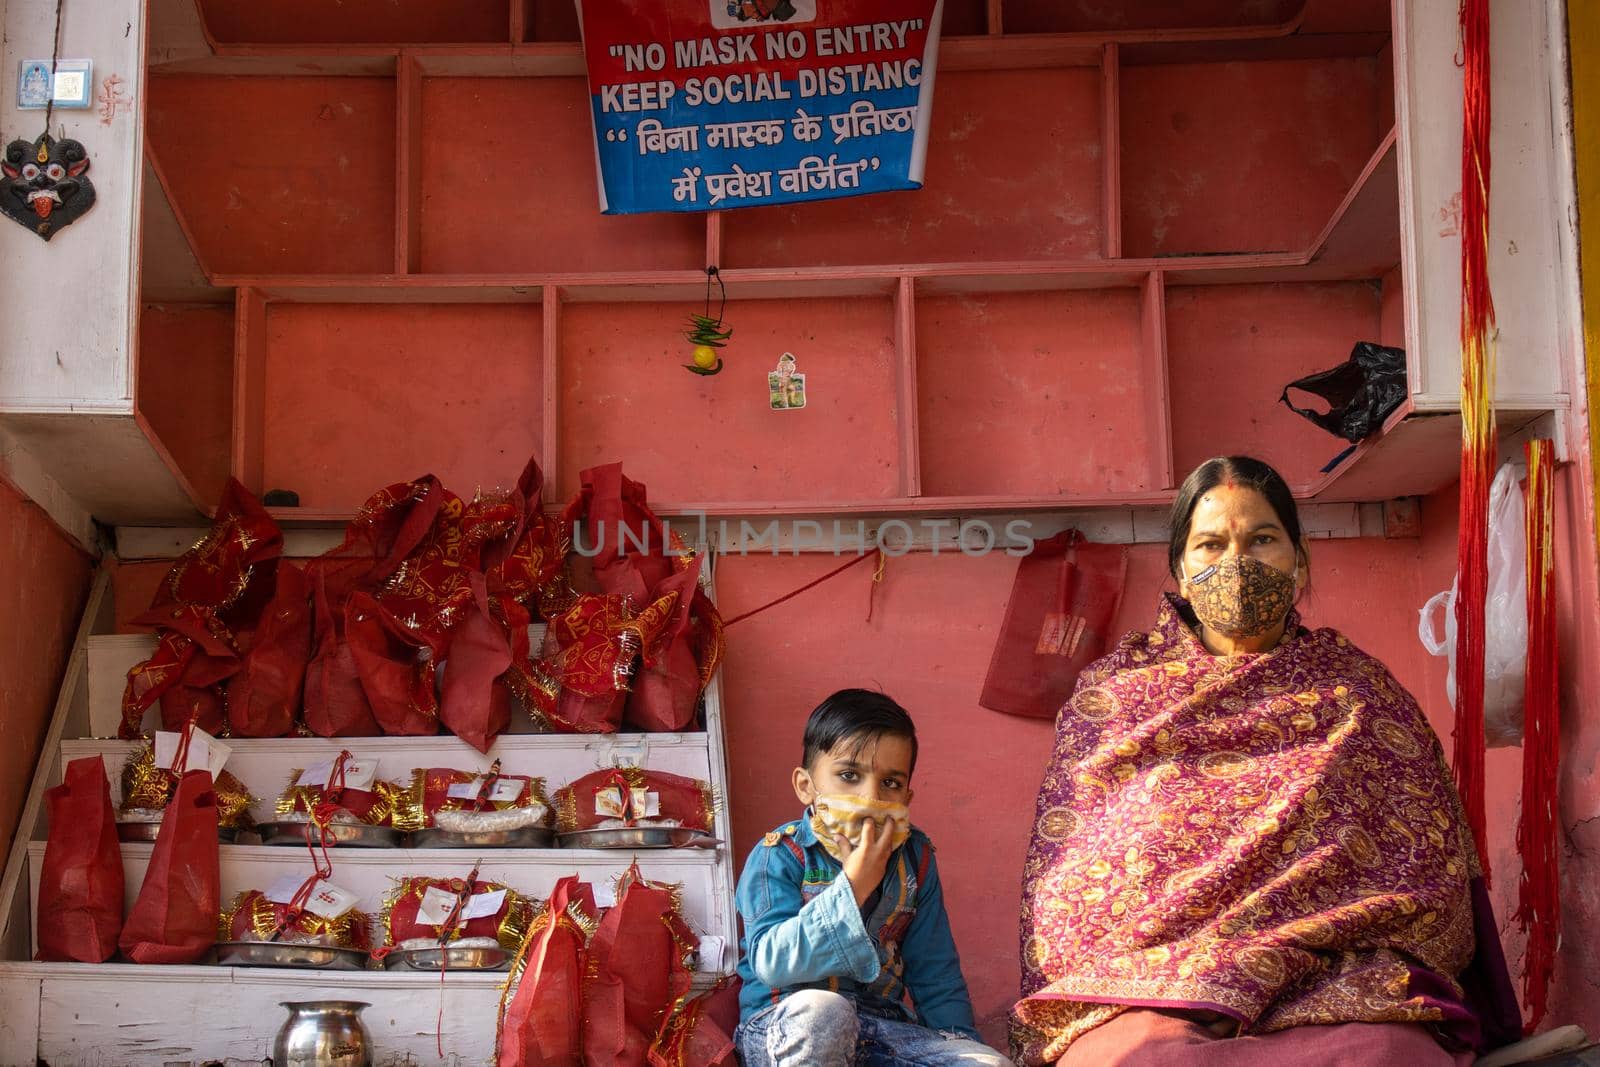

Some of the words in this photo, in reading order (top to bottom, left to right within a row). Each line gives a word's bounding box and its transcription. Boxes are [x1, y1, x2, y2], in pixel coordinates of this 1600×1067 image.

[608, 43, 667, 72] "NO
[674, 33, 758, 69] MASK
[765, 30, 808, 61] NO
[815, 18, 923, 57] ENTRY"
[601, 80, 676, 113] KEEP
[684, 71, 792, 107] SOCIAL
[800, 57, 921, 98] DISTANC
[704, 119, 786, 149] मास्क
[791, 107, 823, 142] के
[671, 166, 702, 202] में
[704, 163, 772, 206] प्रवेश
